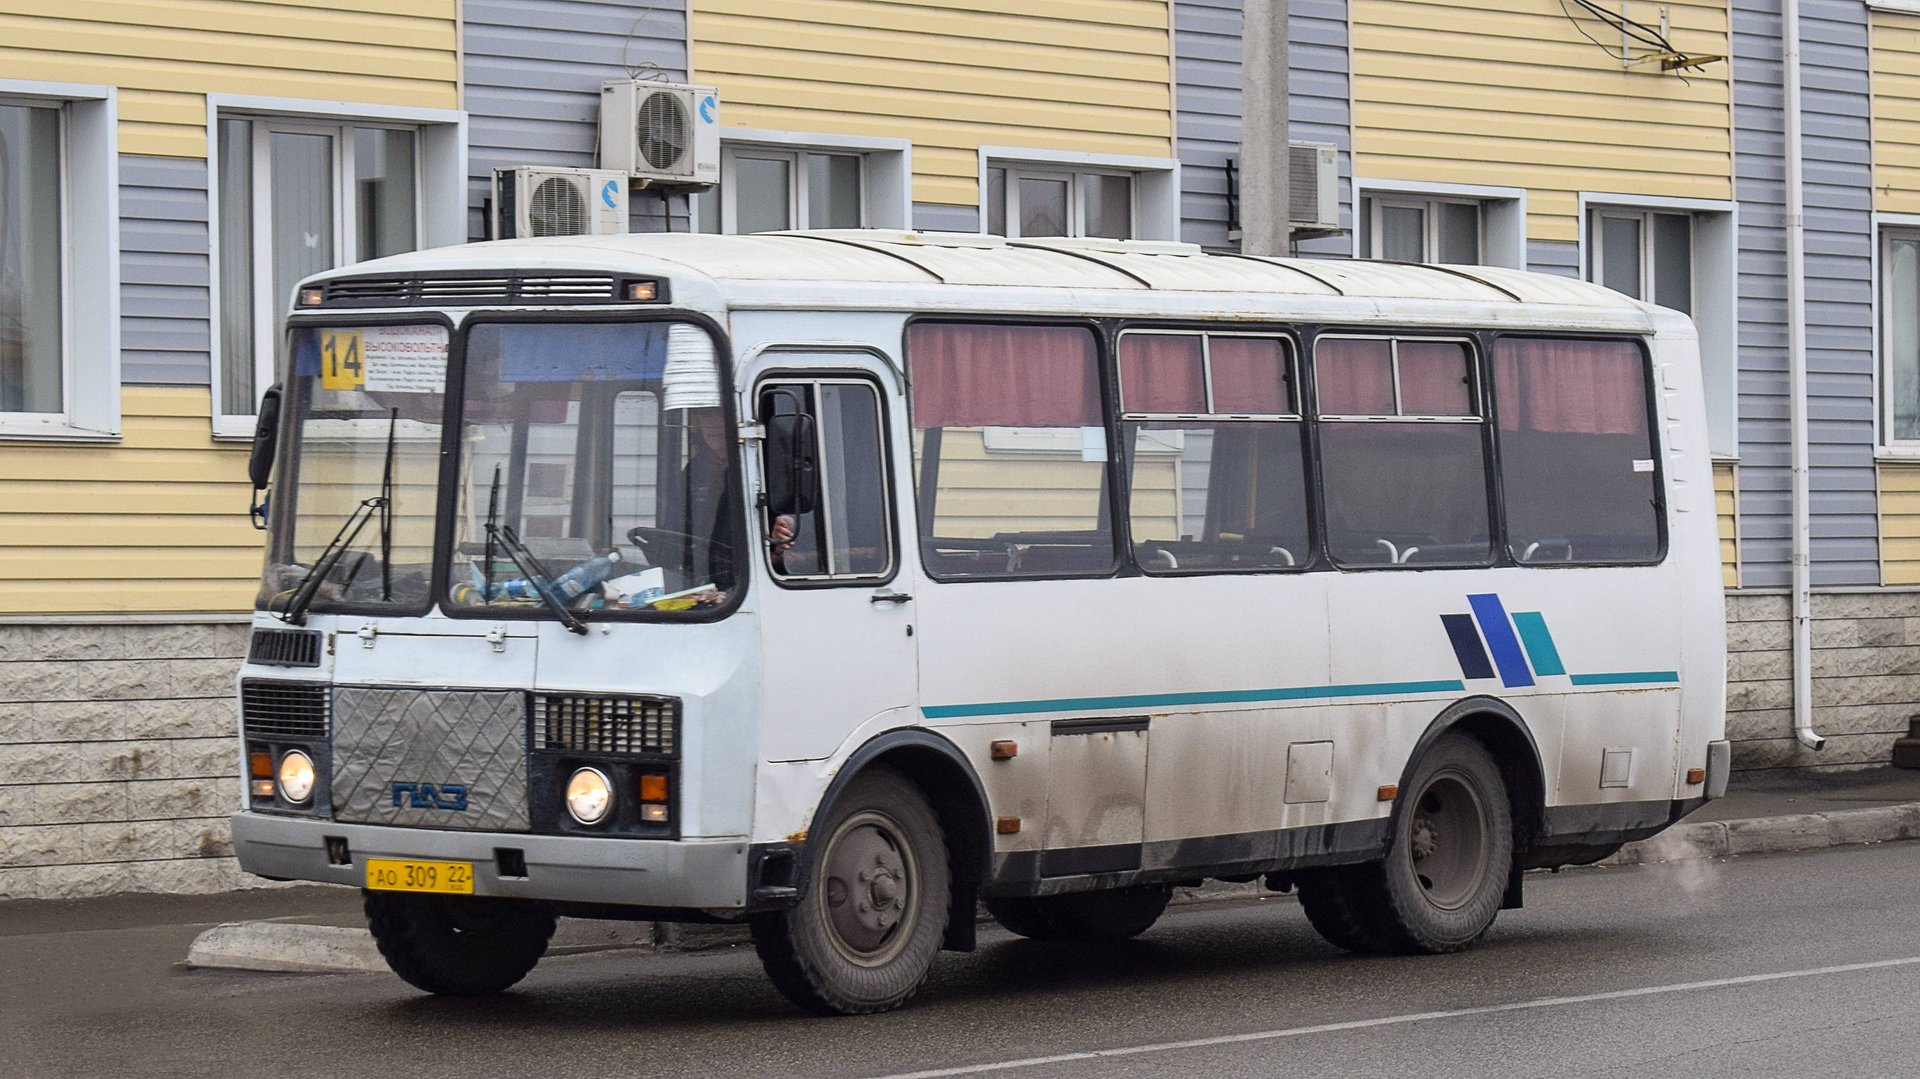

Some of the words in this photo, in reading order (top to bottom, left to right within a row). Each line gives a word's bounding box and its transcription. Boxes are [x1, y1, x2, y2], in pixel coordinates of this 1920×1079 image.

[324, 334, 362, 378] 14
[391, 781, 467, 811] ПАЗ
[376, 868, 397, 886] АО
[404, 865, 437, 888] 309
[448, 865, 465, 883] 22
